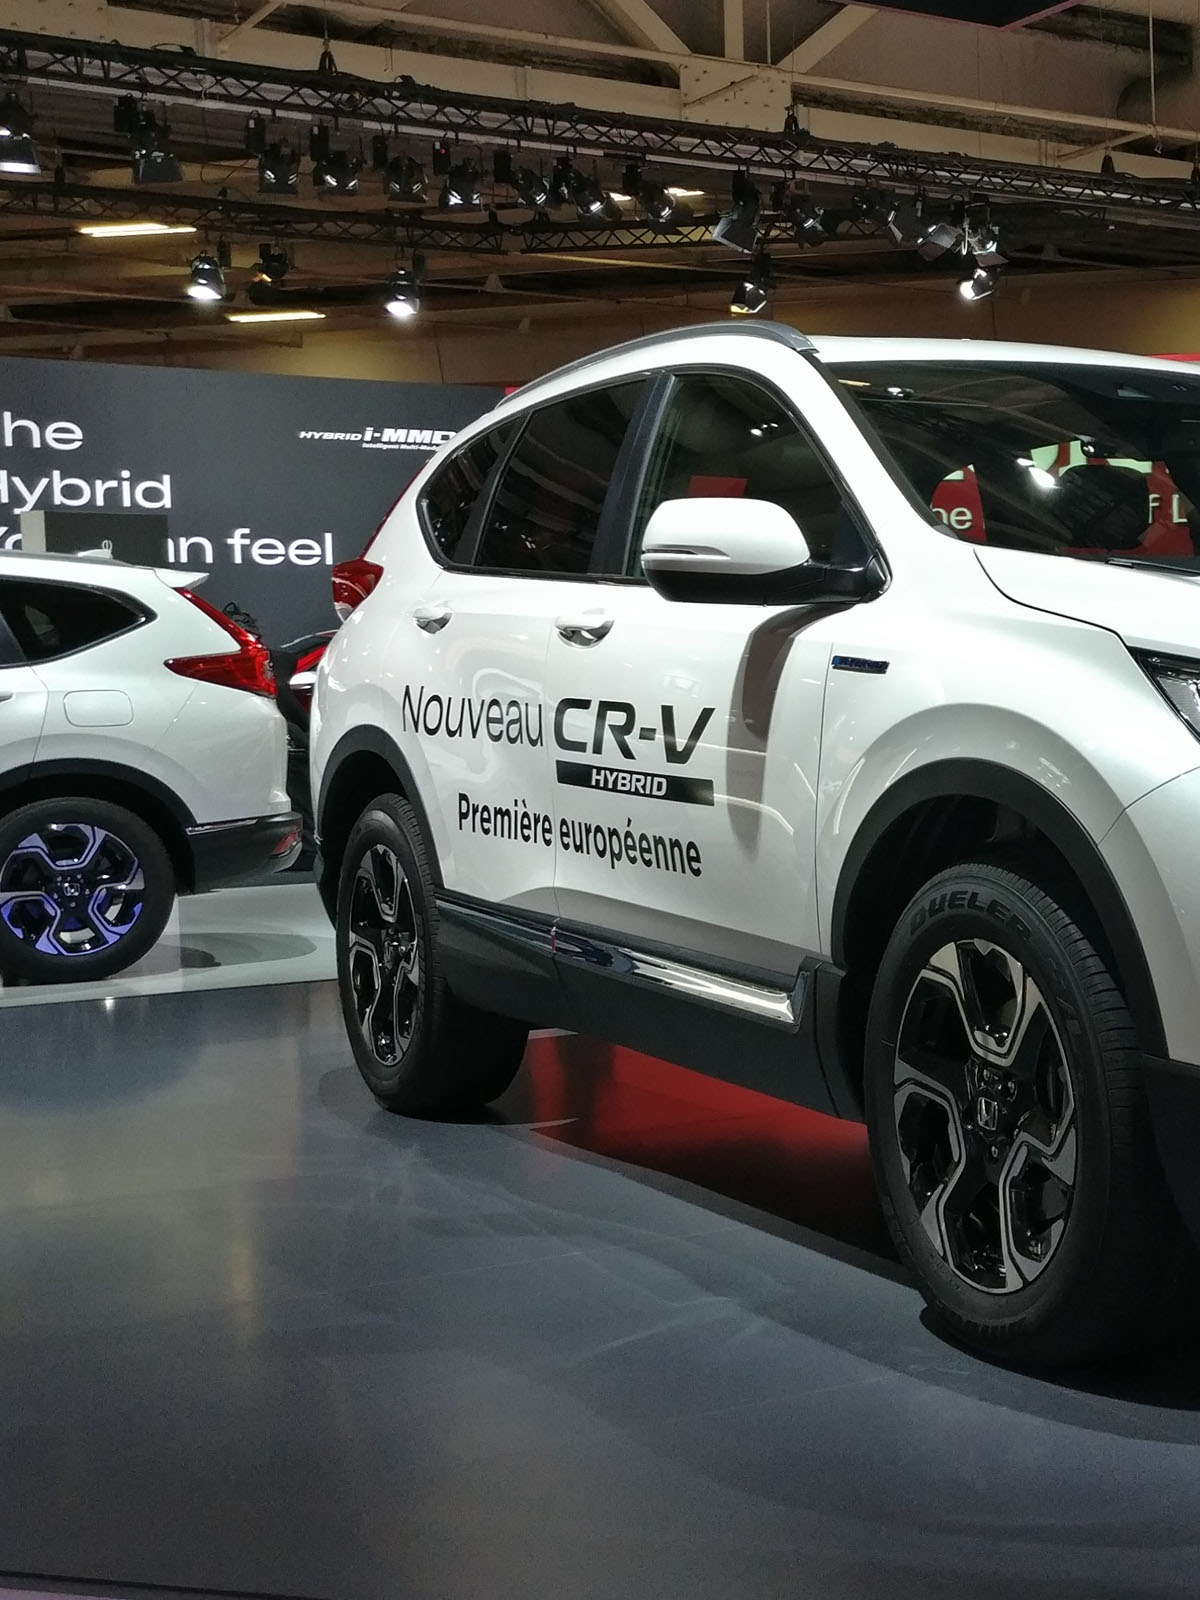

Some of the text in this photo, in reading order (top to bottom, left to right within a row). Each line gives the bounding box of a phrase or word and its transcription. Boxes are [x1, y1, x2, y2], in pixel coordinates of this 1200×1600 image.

[299, 430, 362, 441] HYBRID
[226, 527, 334, 566] feel
[401, 684, 716, 765] Nouveau CR-V
[590, 768, 668, 797] HYBRID
[458, 792, 703, 878] Première européenne
[909, 889, 1033, 941] DUELER
